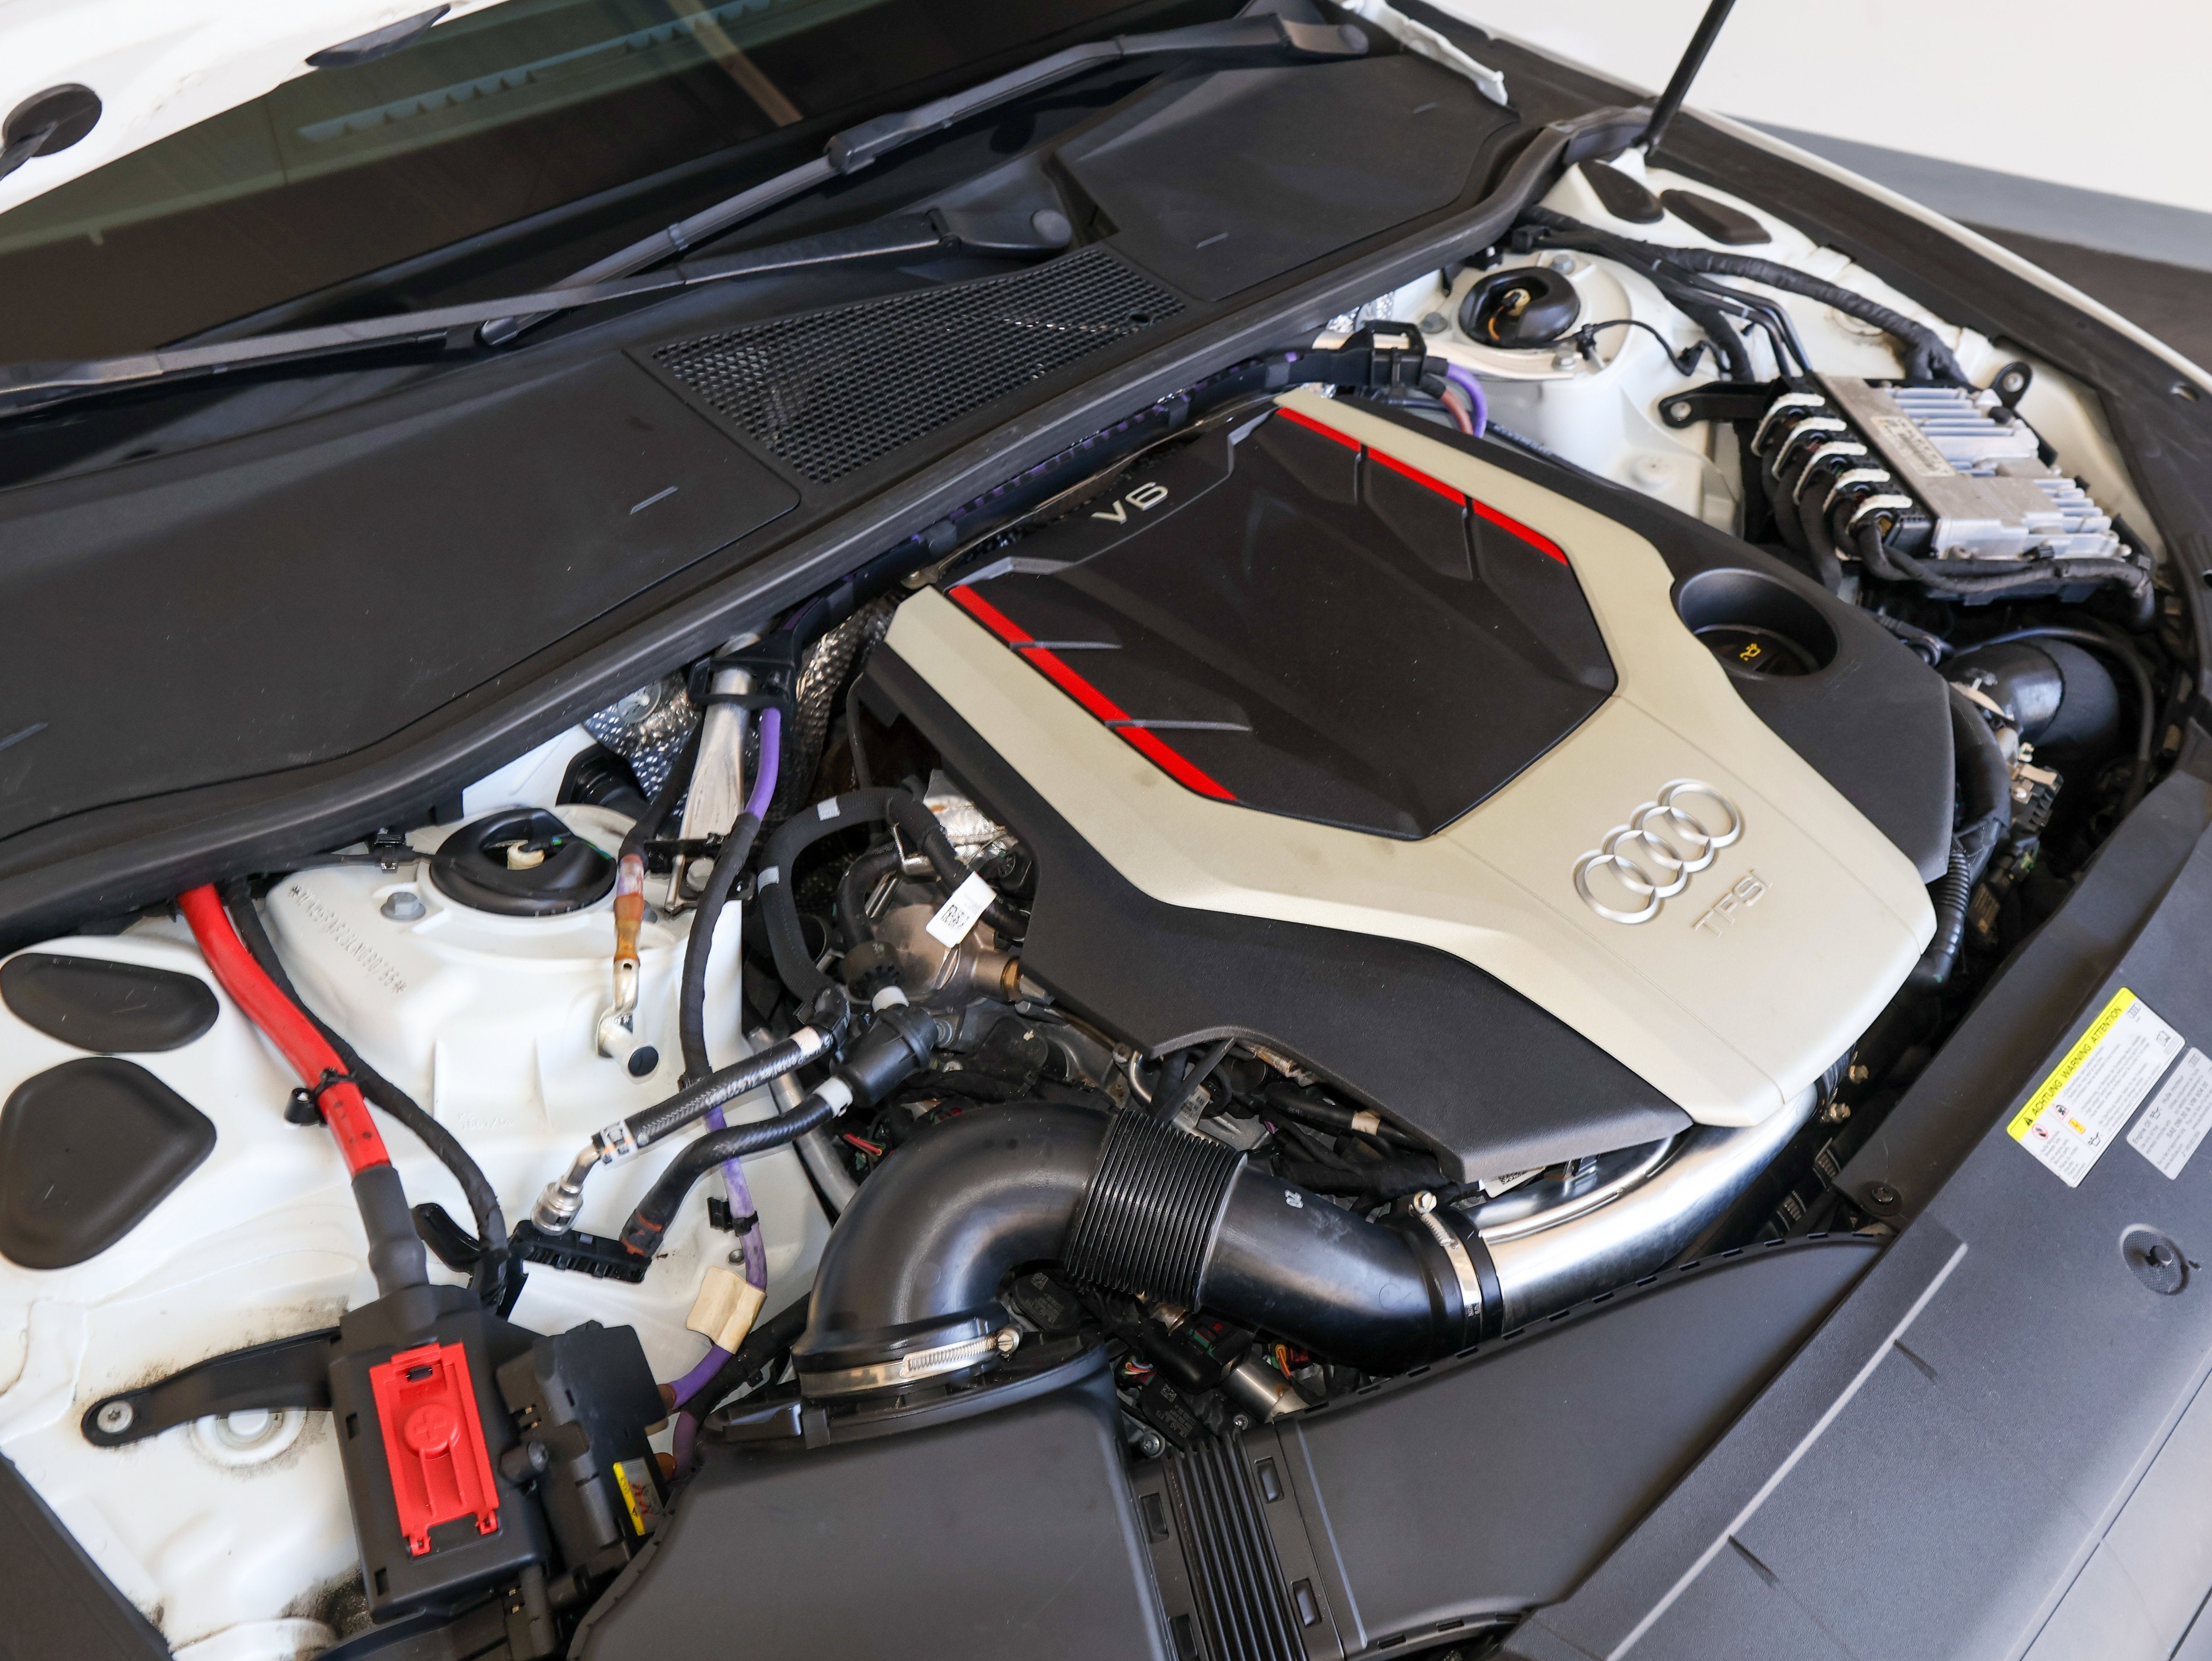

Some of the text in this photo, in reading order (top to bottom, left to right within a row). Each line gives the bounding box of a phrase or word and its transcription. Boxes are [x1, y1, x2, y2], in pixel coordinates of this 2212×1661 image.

[1091, 482, 1169, 524] V6
[1692, 869, 1773, 938] TFSI
[2030, 1079, 2063, 1116] ACHTUNG
[2060, 1043, 2092, 1078] WARNING
[2089, 1005, 2122, 1043] ATTENTION
[1285, 1190, 1303, 1208] 20
